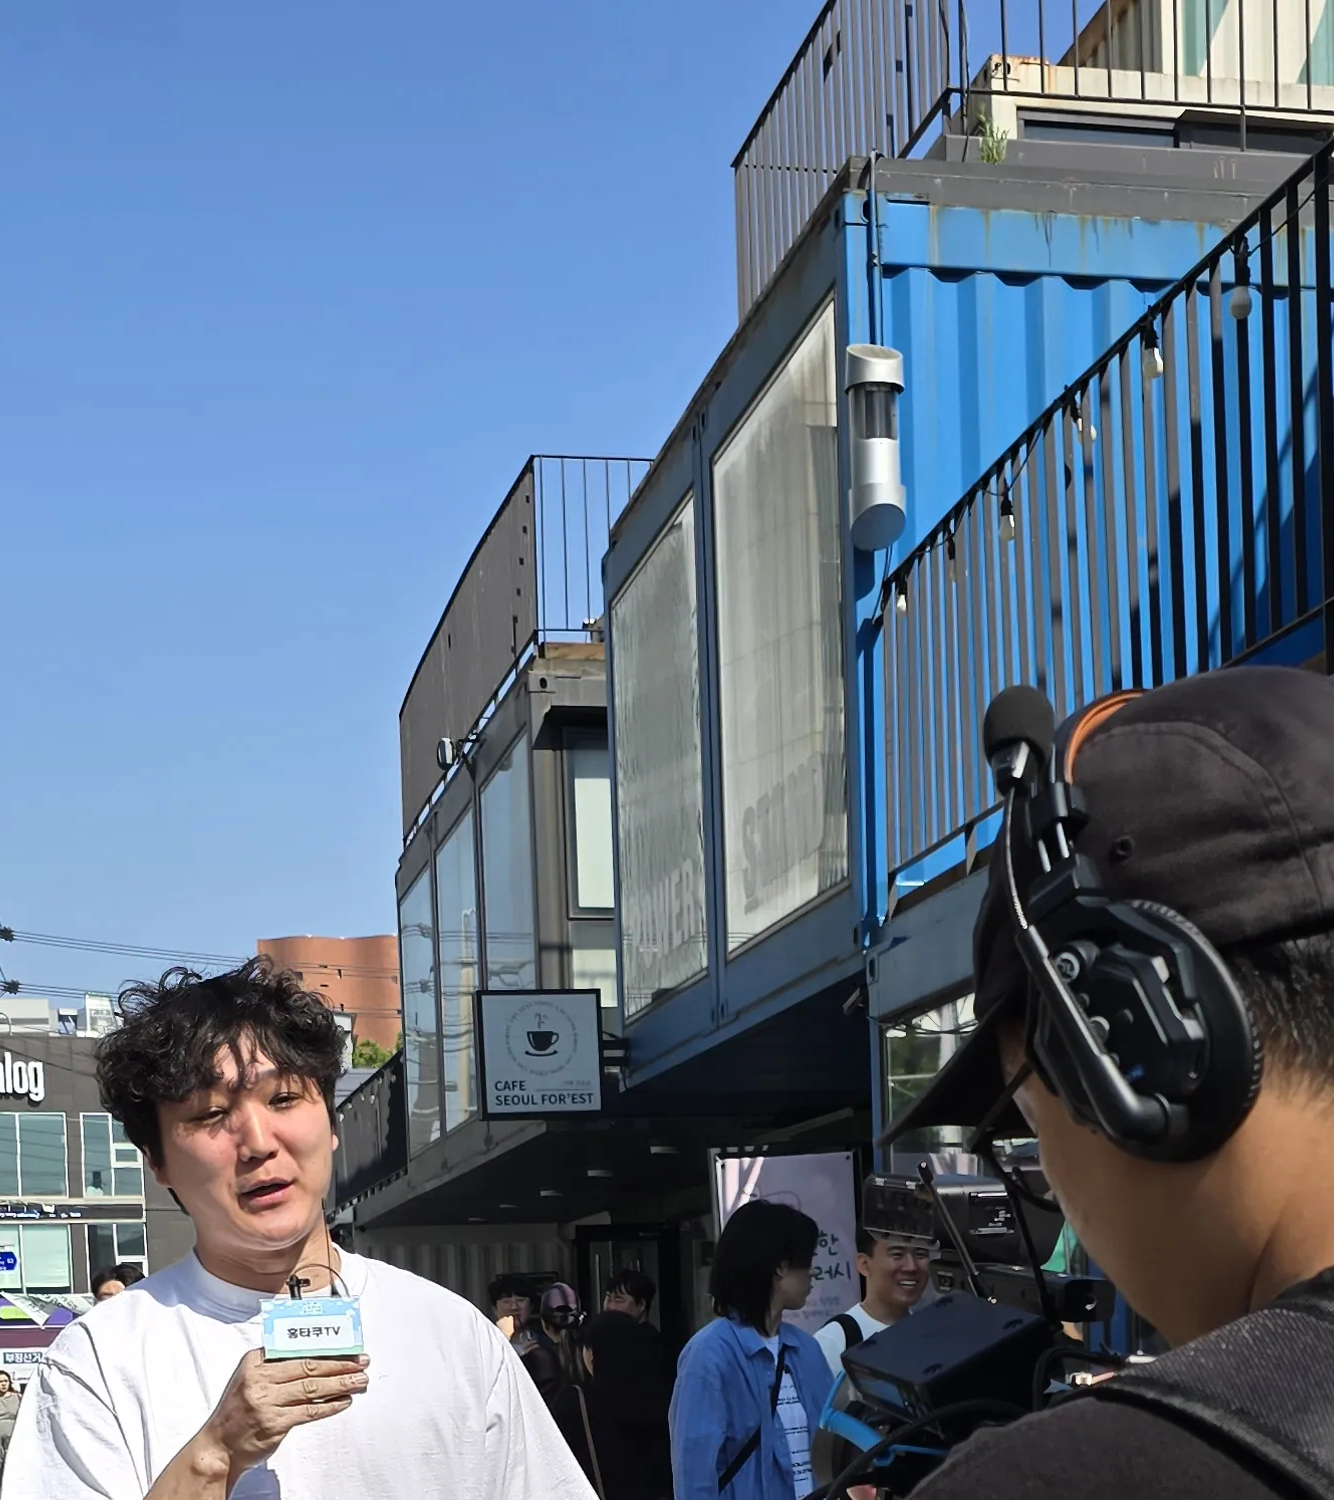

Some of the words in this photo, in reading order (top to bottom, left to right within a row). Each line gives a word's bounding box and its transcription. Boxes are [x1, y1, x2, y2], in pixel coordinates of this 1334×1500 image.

[494, 1080, 527, 1092] CAFE
[495, 1094, 538, 1107] SEOUL
[541, 1092, 594, 1105] FOR'EST
